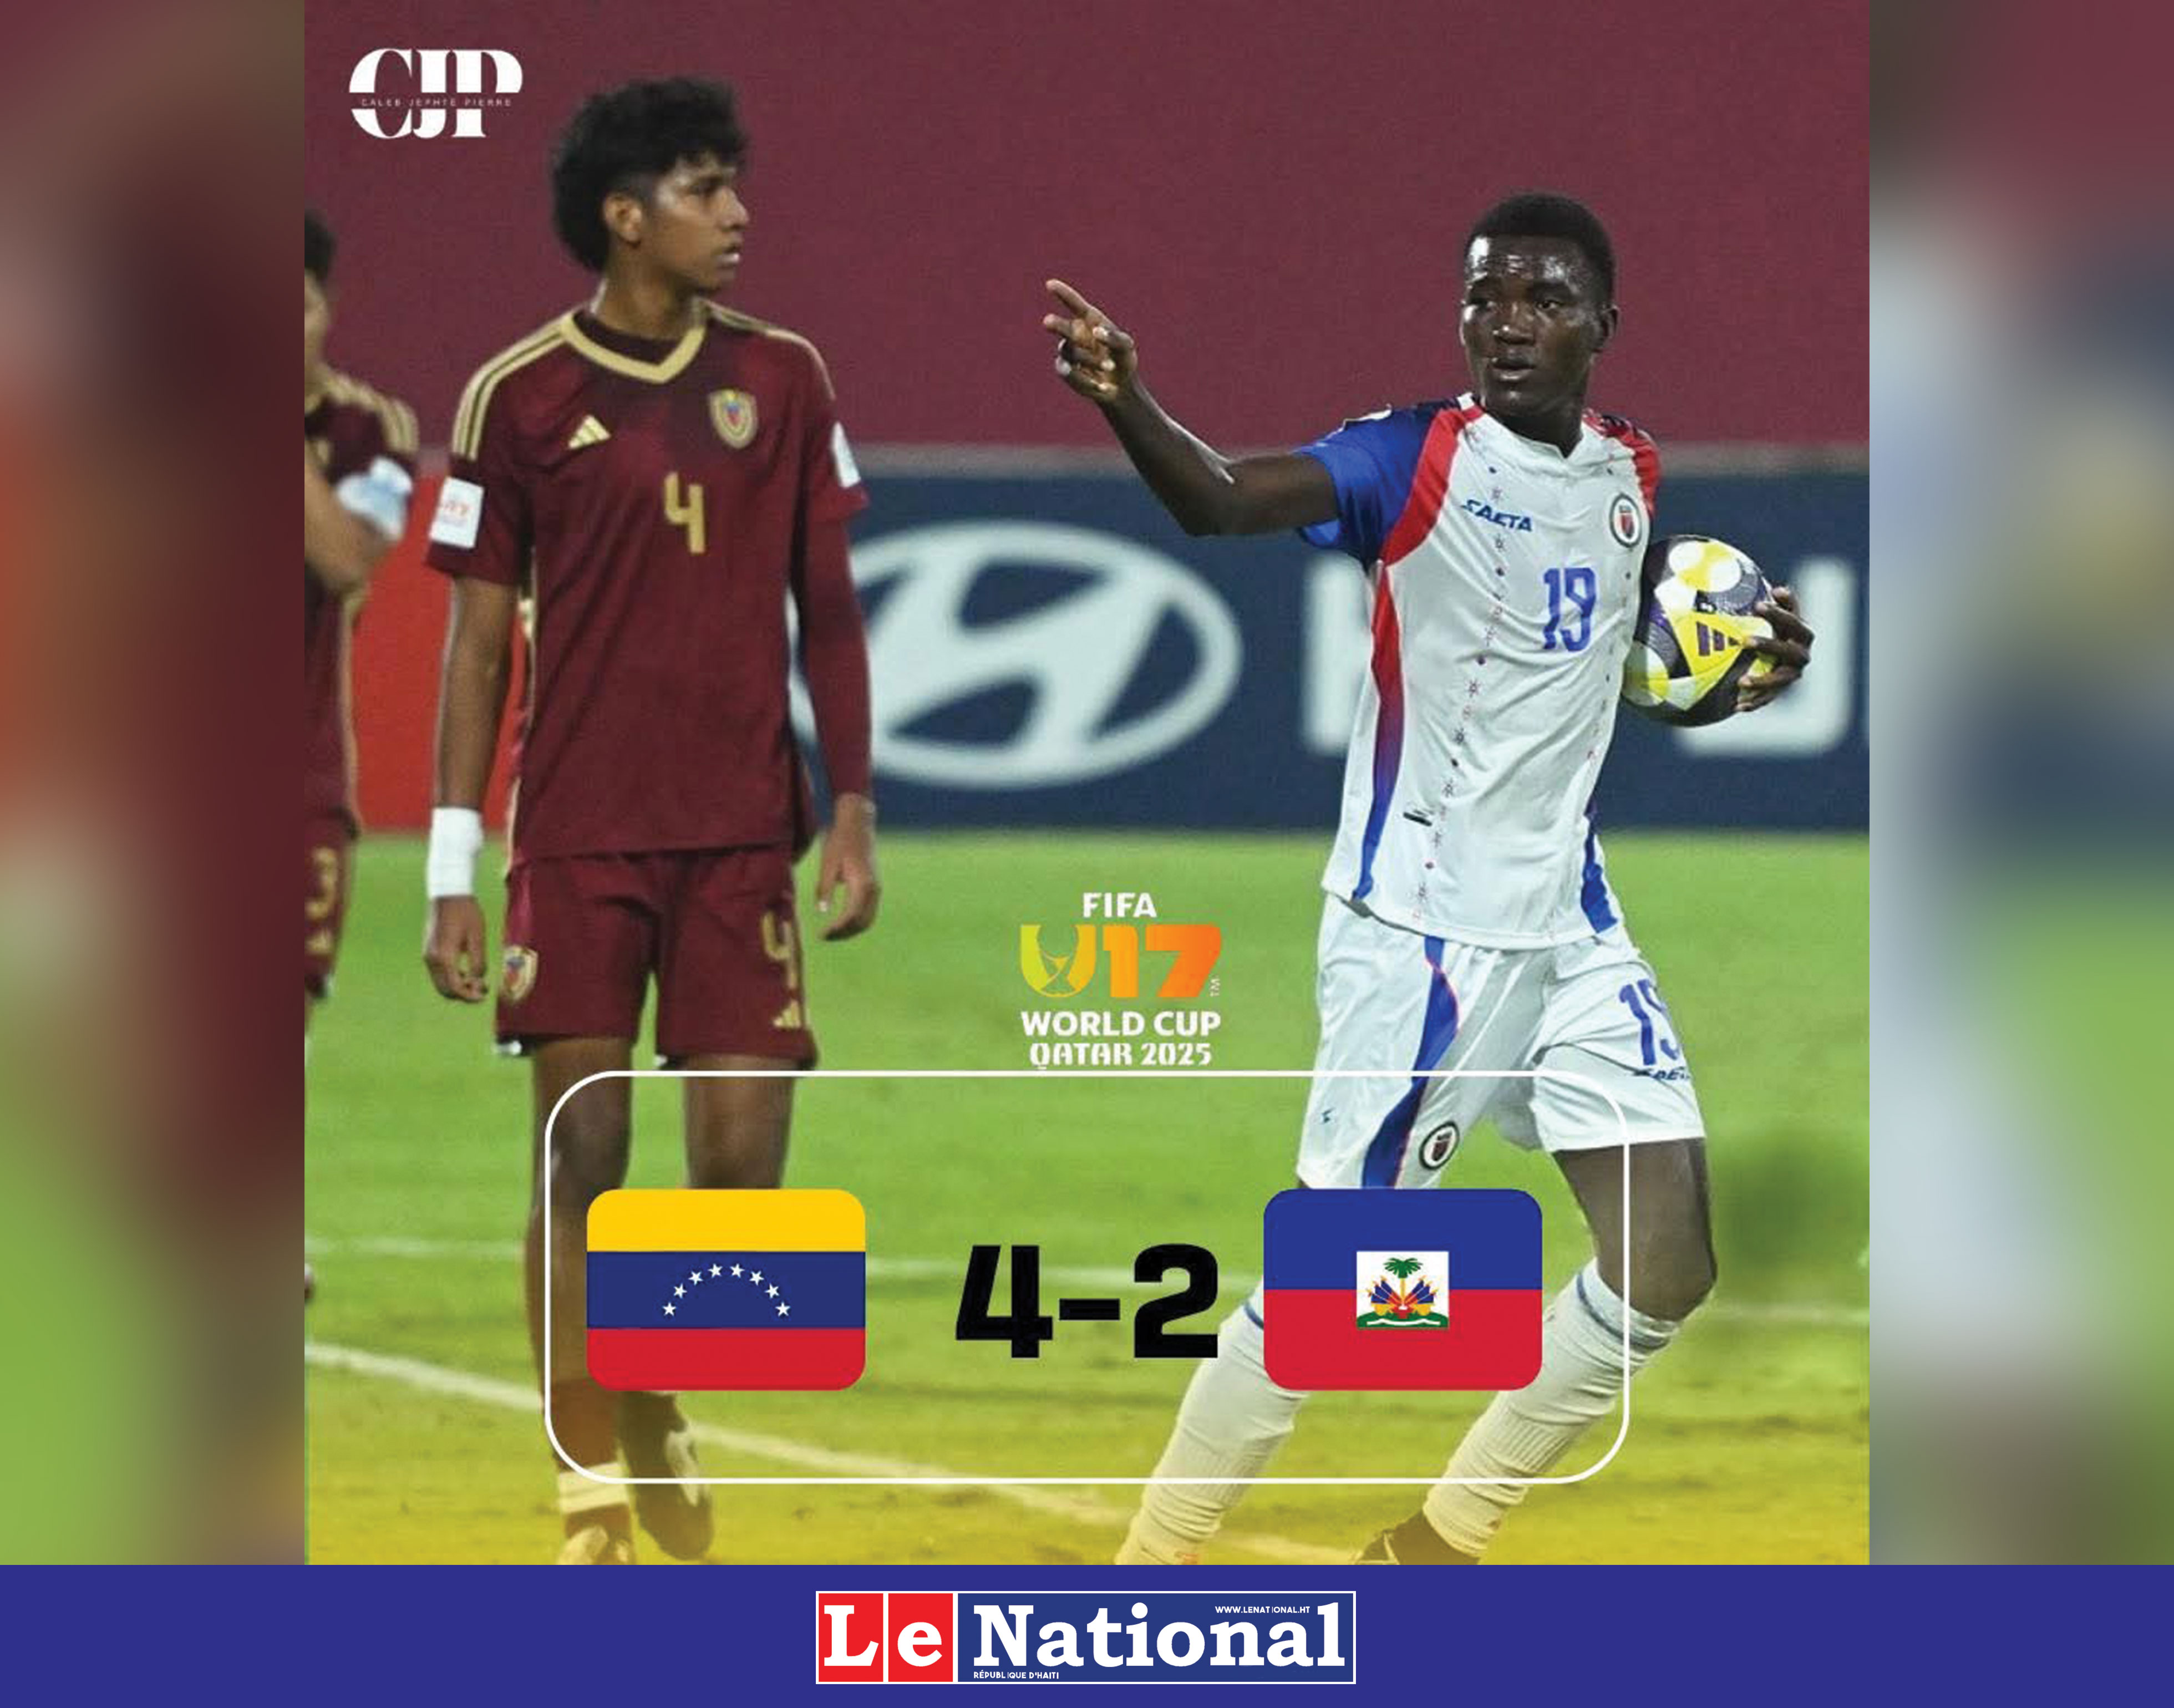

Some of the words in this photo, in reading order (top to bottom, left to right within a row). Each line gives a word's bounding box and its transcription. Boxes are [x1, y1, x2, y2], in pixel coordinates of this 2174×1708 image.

[664, 472, 706, 553] 4
[1460, 499, 1532, 532] SAETA
[1543, 567, 1596, 651] 19
[760, 911, 799, 990] 4
